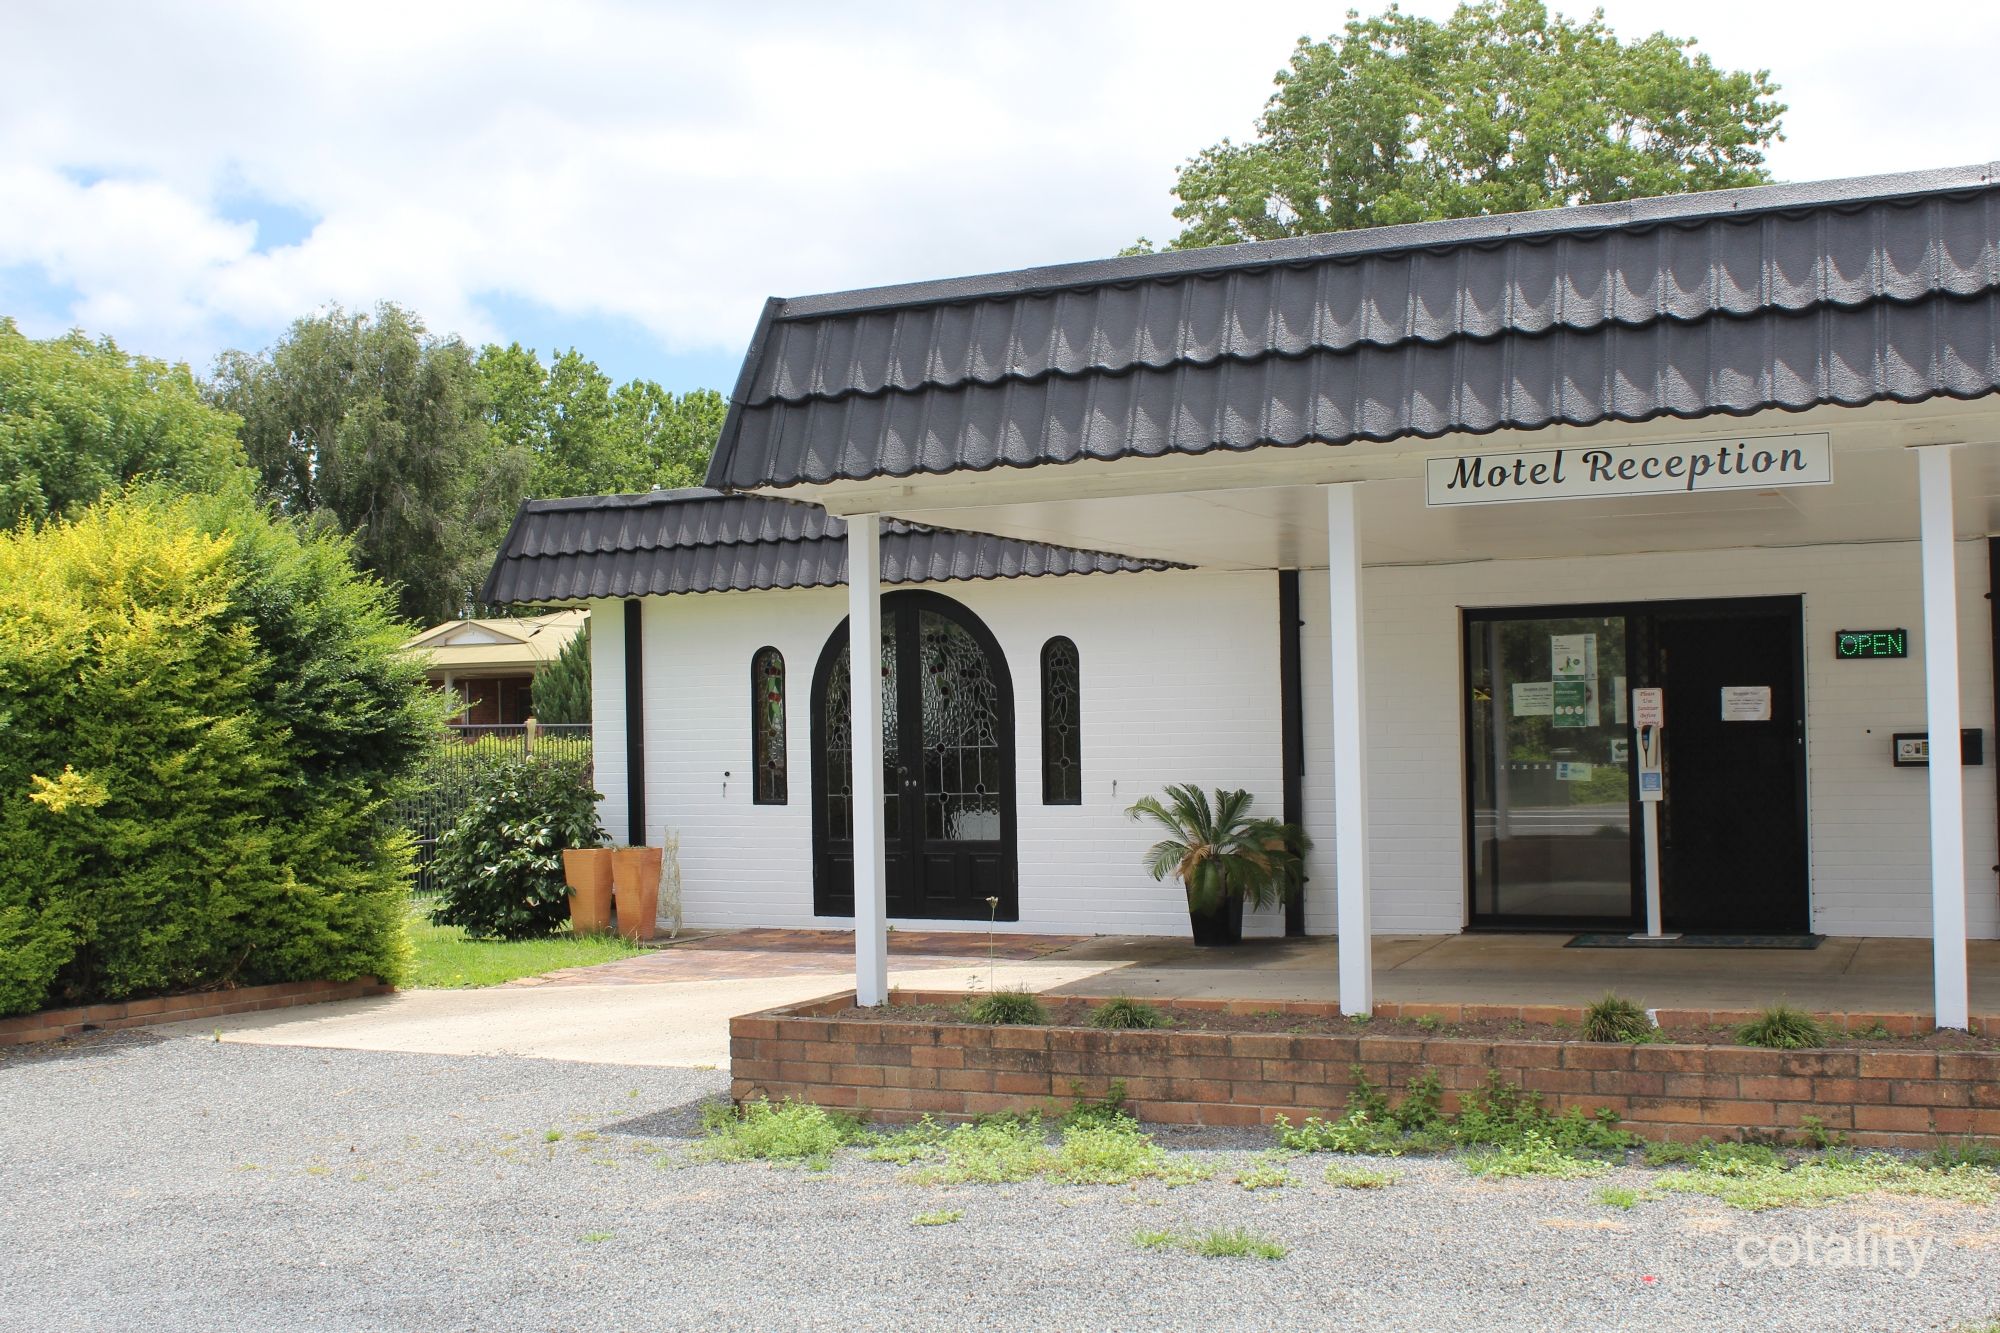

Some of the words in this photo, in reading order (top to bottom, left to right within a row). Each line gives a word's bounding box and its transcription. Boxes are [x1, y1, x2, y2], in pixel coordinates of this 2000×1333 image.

[1446, 449, 1566, 490] Motel
[1581, 443, 1808, 490] Reception
[1840, 633, 1902, 656] OPEN
